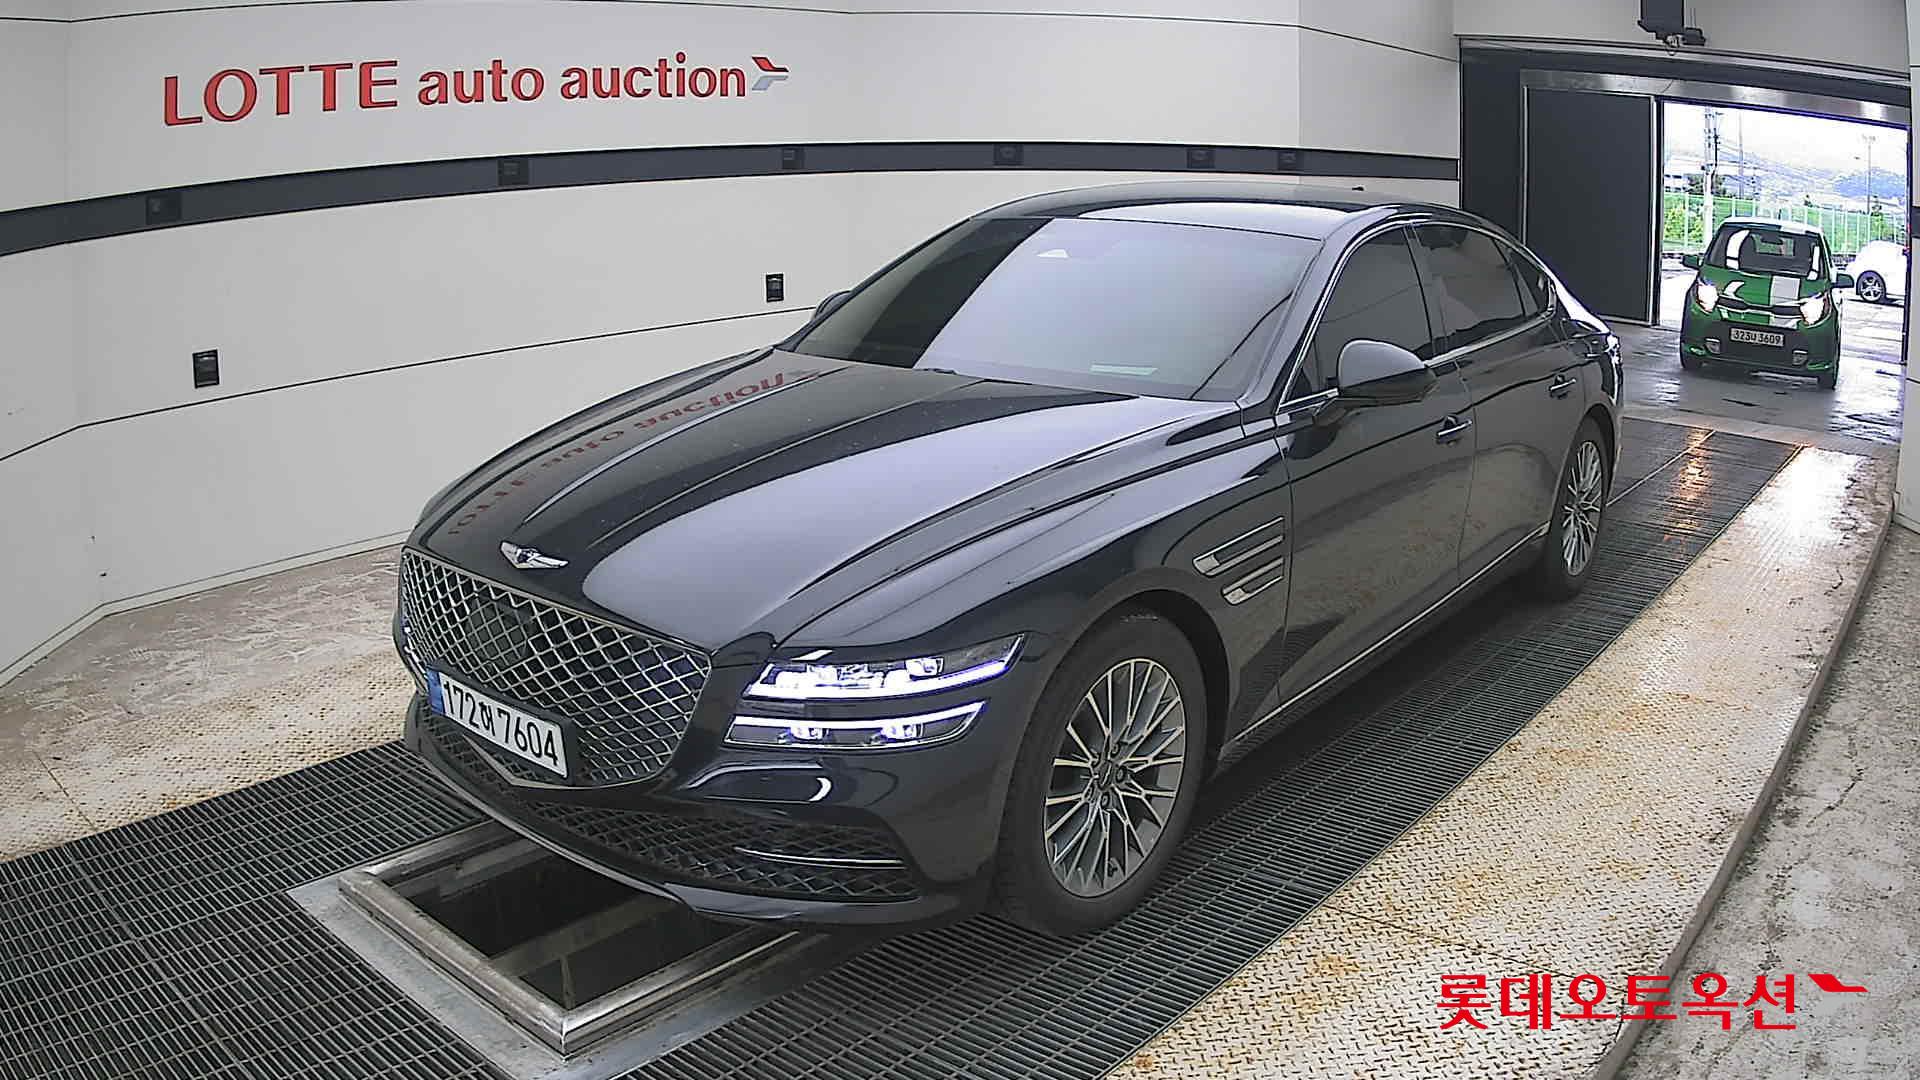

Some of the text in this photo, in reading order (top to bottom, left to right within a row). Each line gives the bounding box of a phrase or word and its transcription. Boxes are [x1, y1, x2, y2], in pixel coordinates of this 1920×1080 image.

[164, 52, 746, 126] LOTTE auto auction
